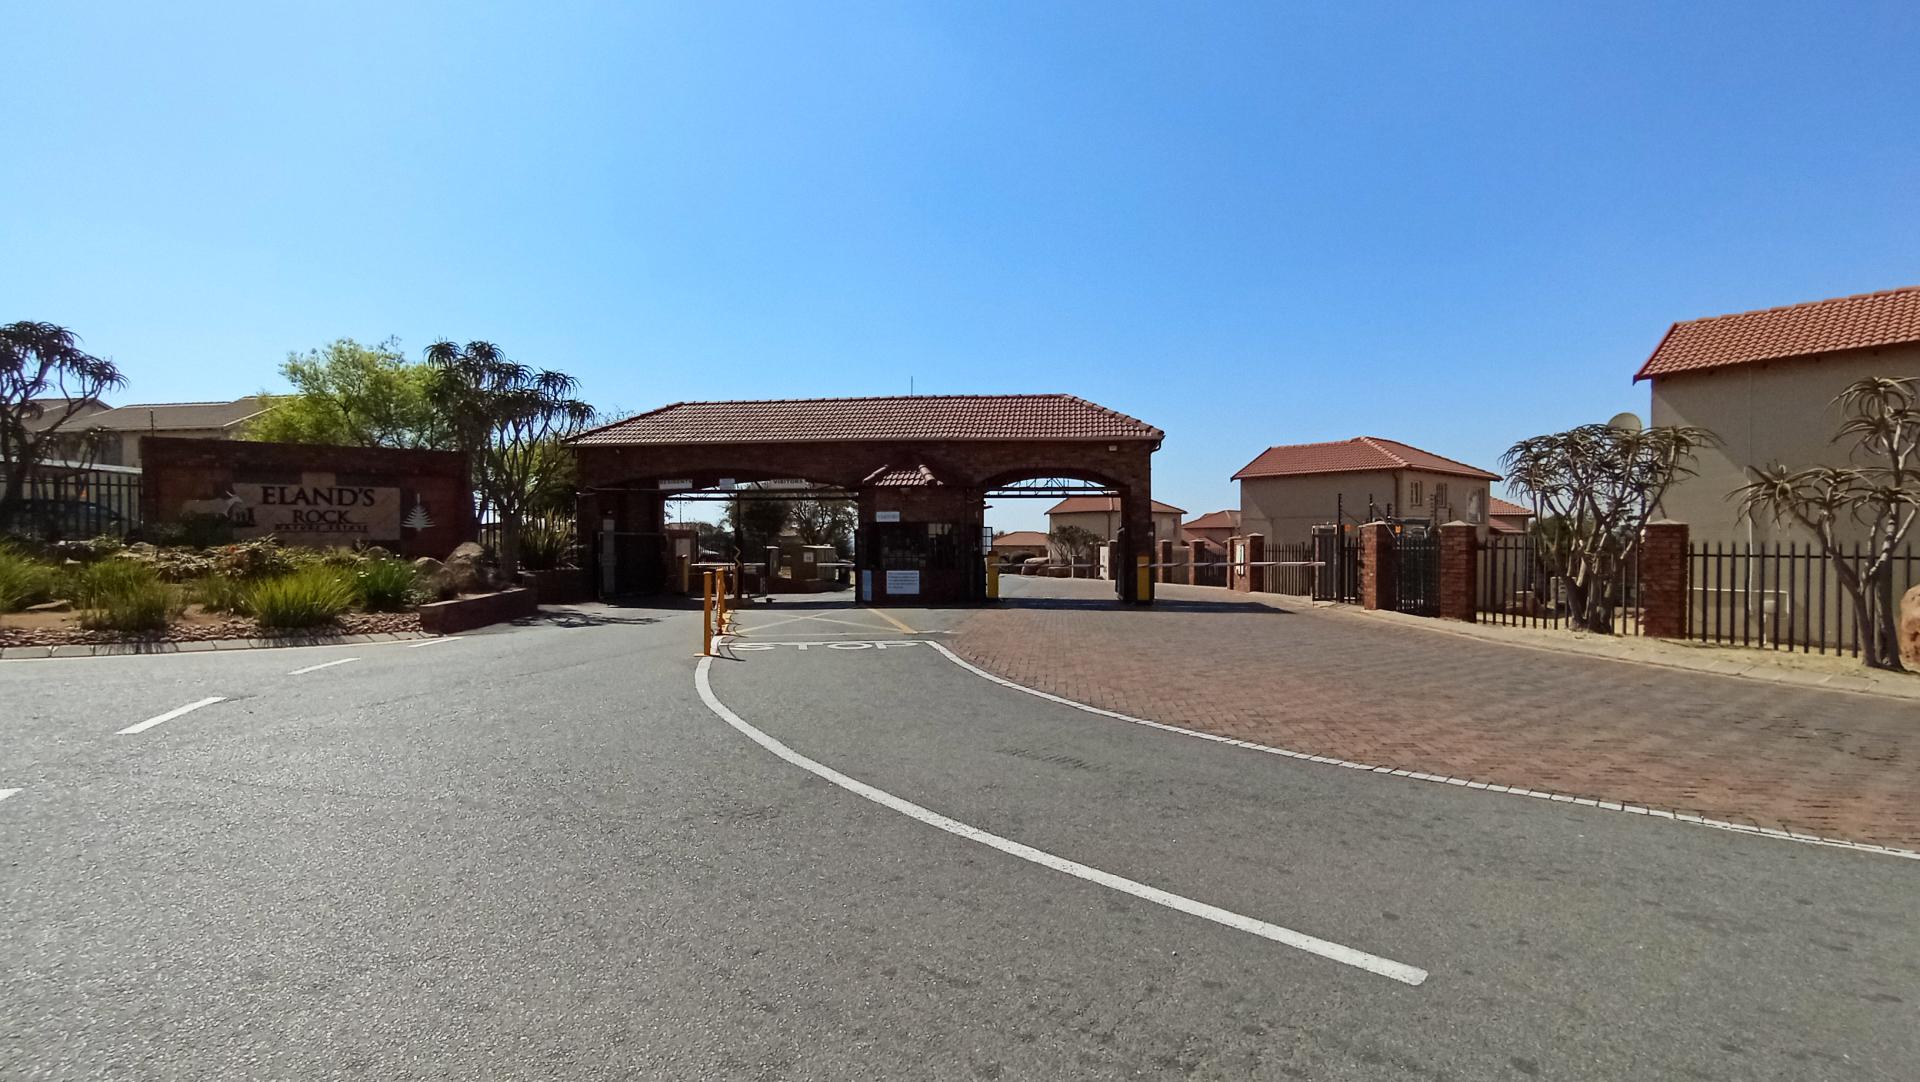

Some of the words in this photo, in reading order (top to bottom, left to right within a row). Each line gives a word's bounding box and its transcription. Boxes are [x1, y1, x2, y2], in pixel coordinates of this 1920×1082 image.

[261, 486, 375, 507] ELAND'S
[293, 510, 354, 525] ROCK
[731, 641, 919, 651] STOP
